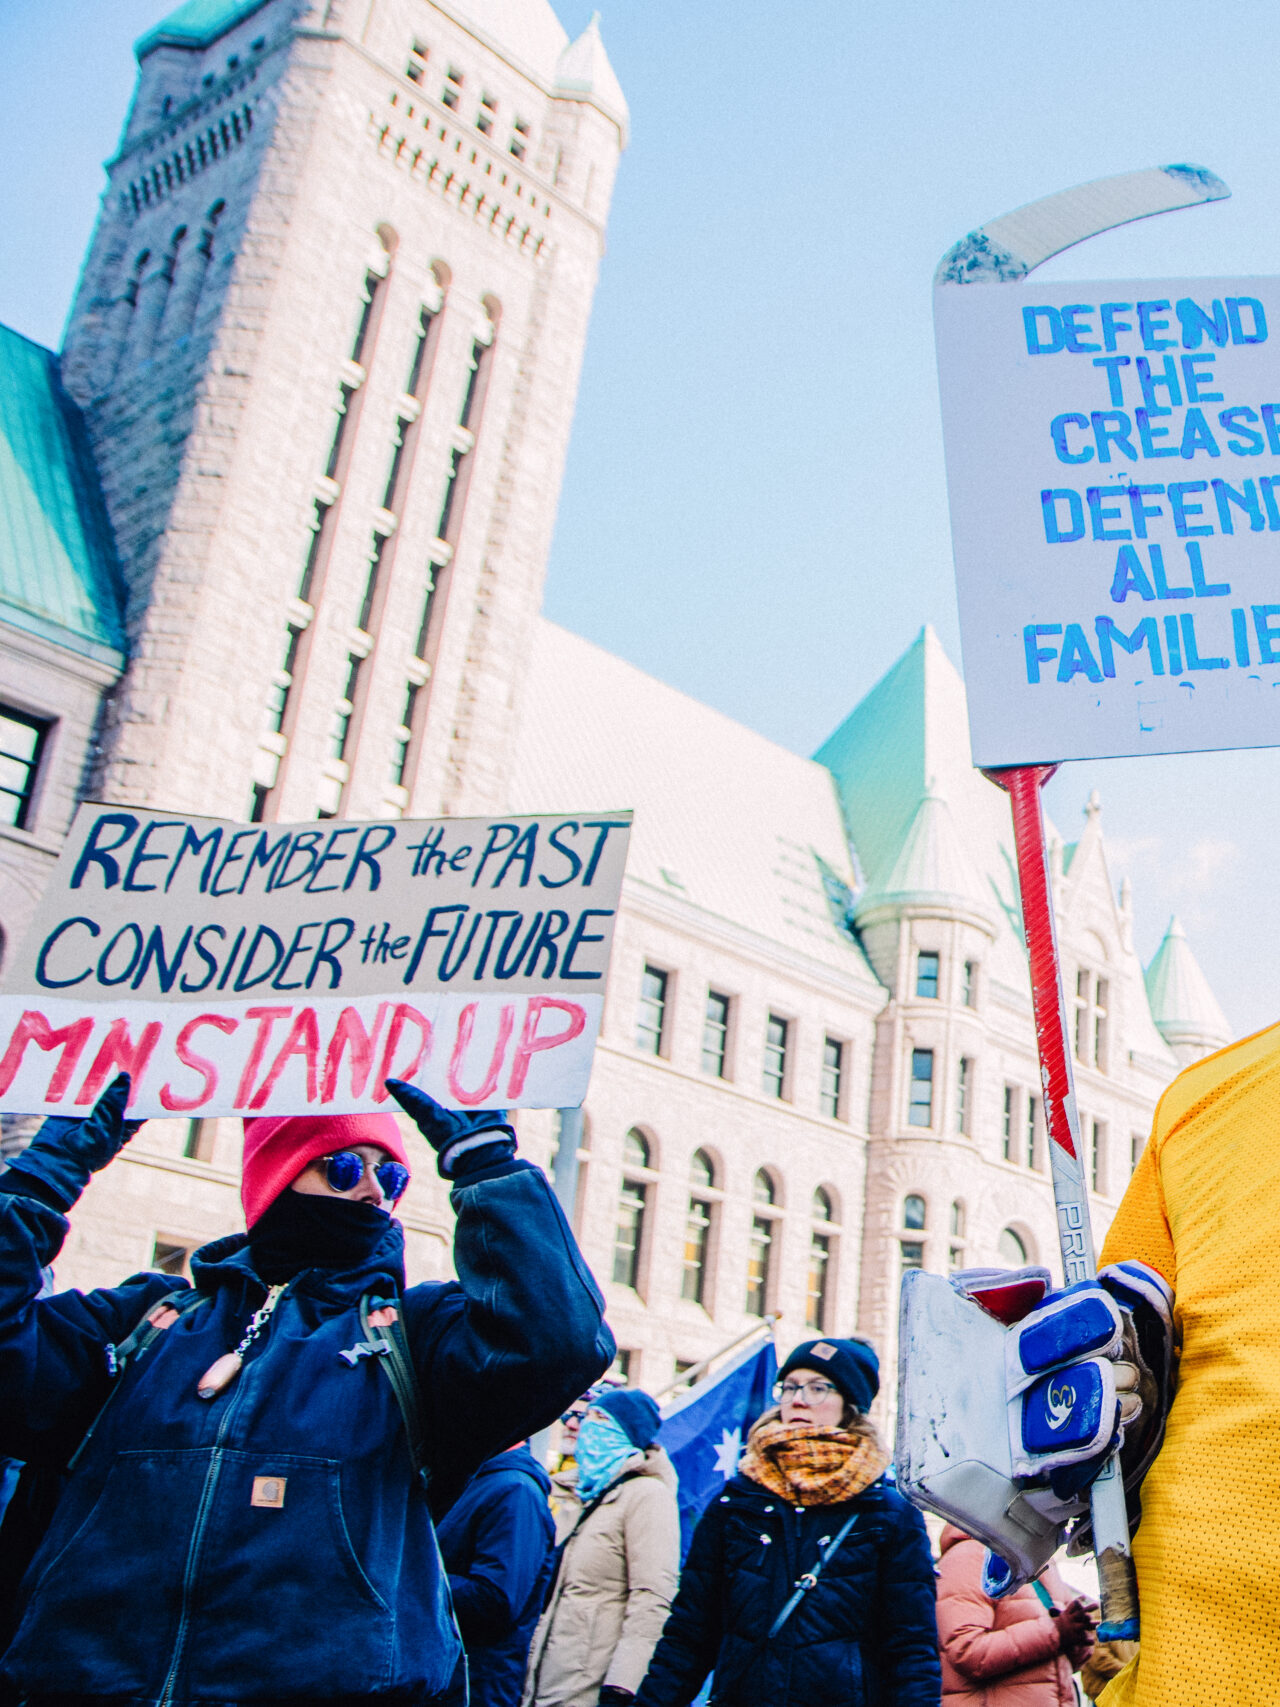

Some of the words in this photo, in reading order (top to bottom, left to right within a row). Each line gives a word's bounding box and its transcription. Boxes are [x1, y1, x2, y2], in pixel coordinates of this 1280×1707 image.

[1022, 297, 1269, 355] DEFEND
[1093, 353, 1224, 408] THE
[1110, 542, 1231, 603] ALL
[70, 813, 398, 898] REMEMBER
[406, 827, 469, 878] the
[472, 820, 632, 889] PAST
[35, 916, 356, 993] CONSIDER
[360, 922, 411, 965] the
[403, 904, 615, 985] FUTURE
[447, 998, 588, 1107] UP
